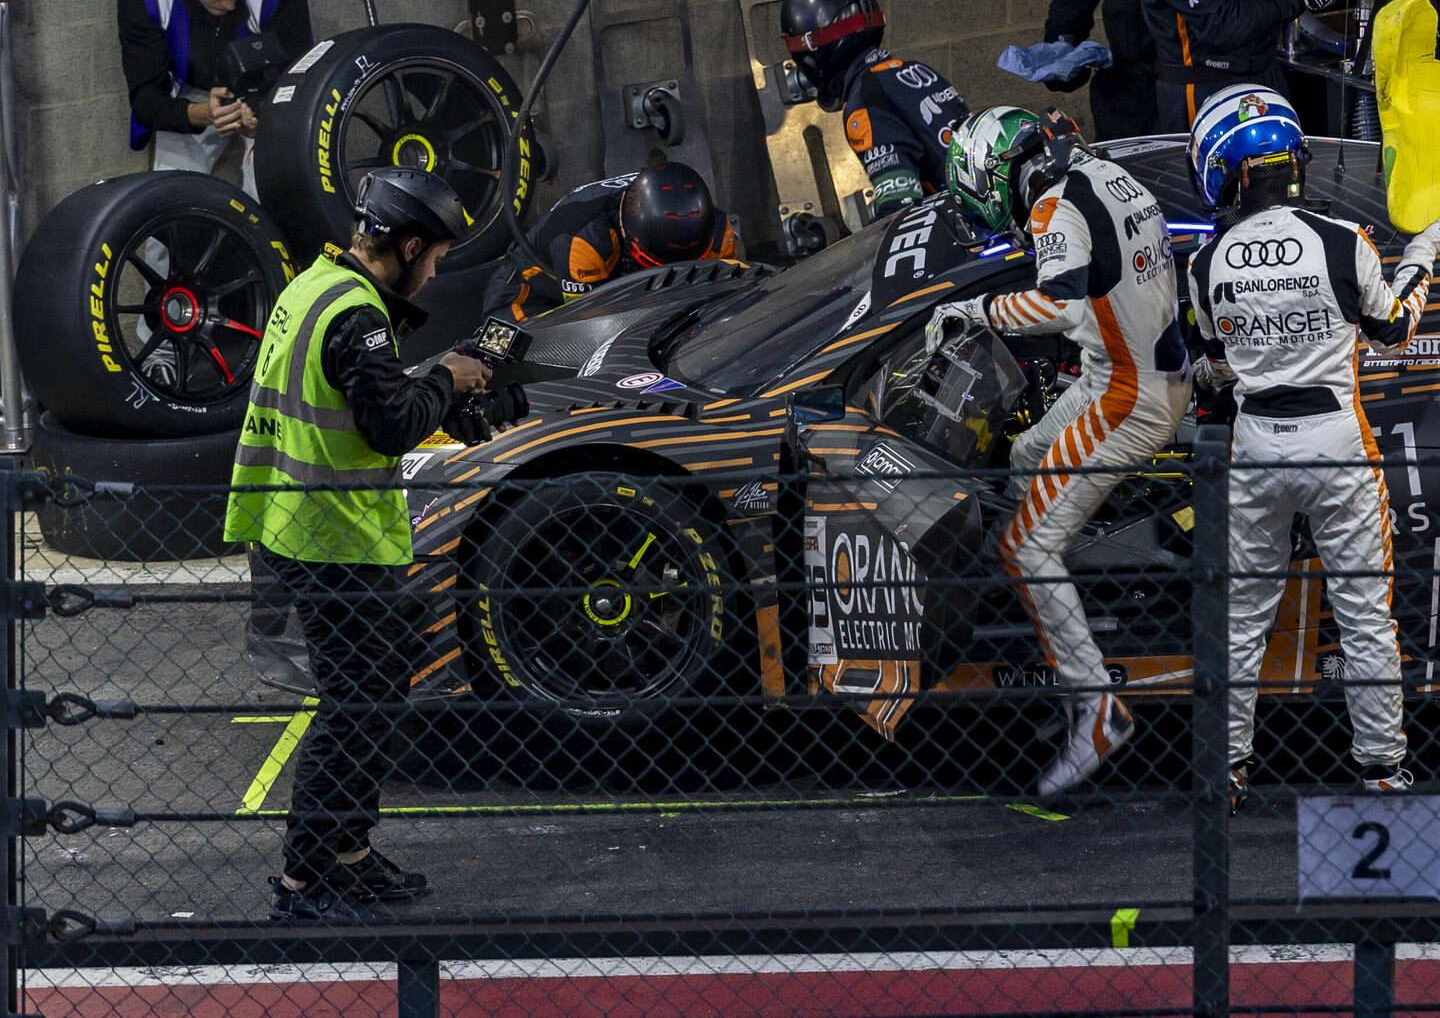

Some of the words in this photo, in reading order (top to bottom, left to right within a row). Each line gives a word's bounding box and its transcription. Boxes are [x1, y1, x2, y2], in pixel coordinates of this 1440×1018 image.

[1205, 59, 1230, 69] freem
[318, 88, 342, 193] PIRELLI
[1235, 275, 1320, 294] SANLORENZO
[90, 243, 123, 372] PIRELLI
[1217, 309, 1331, 337] ORANGE1
[365, 332, 387, 348] OMP
[1222, 336, 1273, 347] ELECTRIC
[1280, 330, 1334, 346] MOTORS
[262, 343, 275, 377] 6
[1273, 423, 1298, 433] freem
[838, 620, 900, 651] ELECTRIC
[1352, 821, 1391, 879] 2
